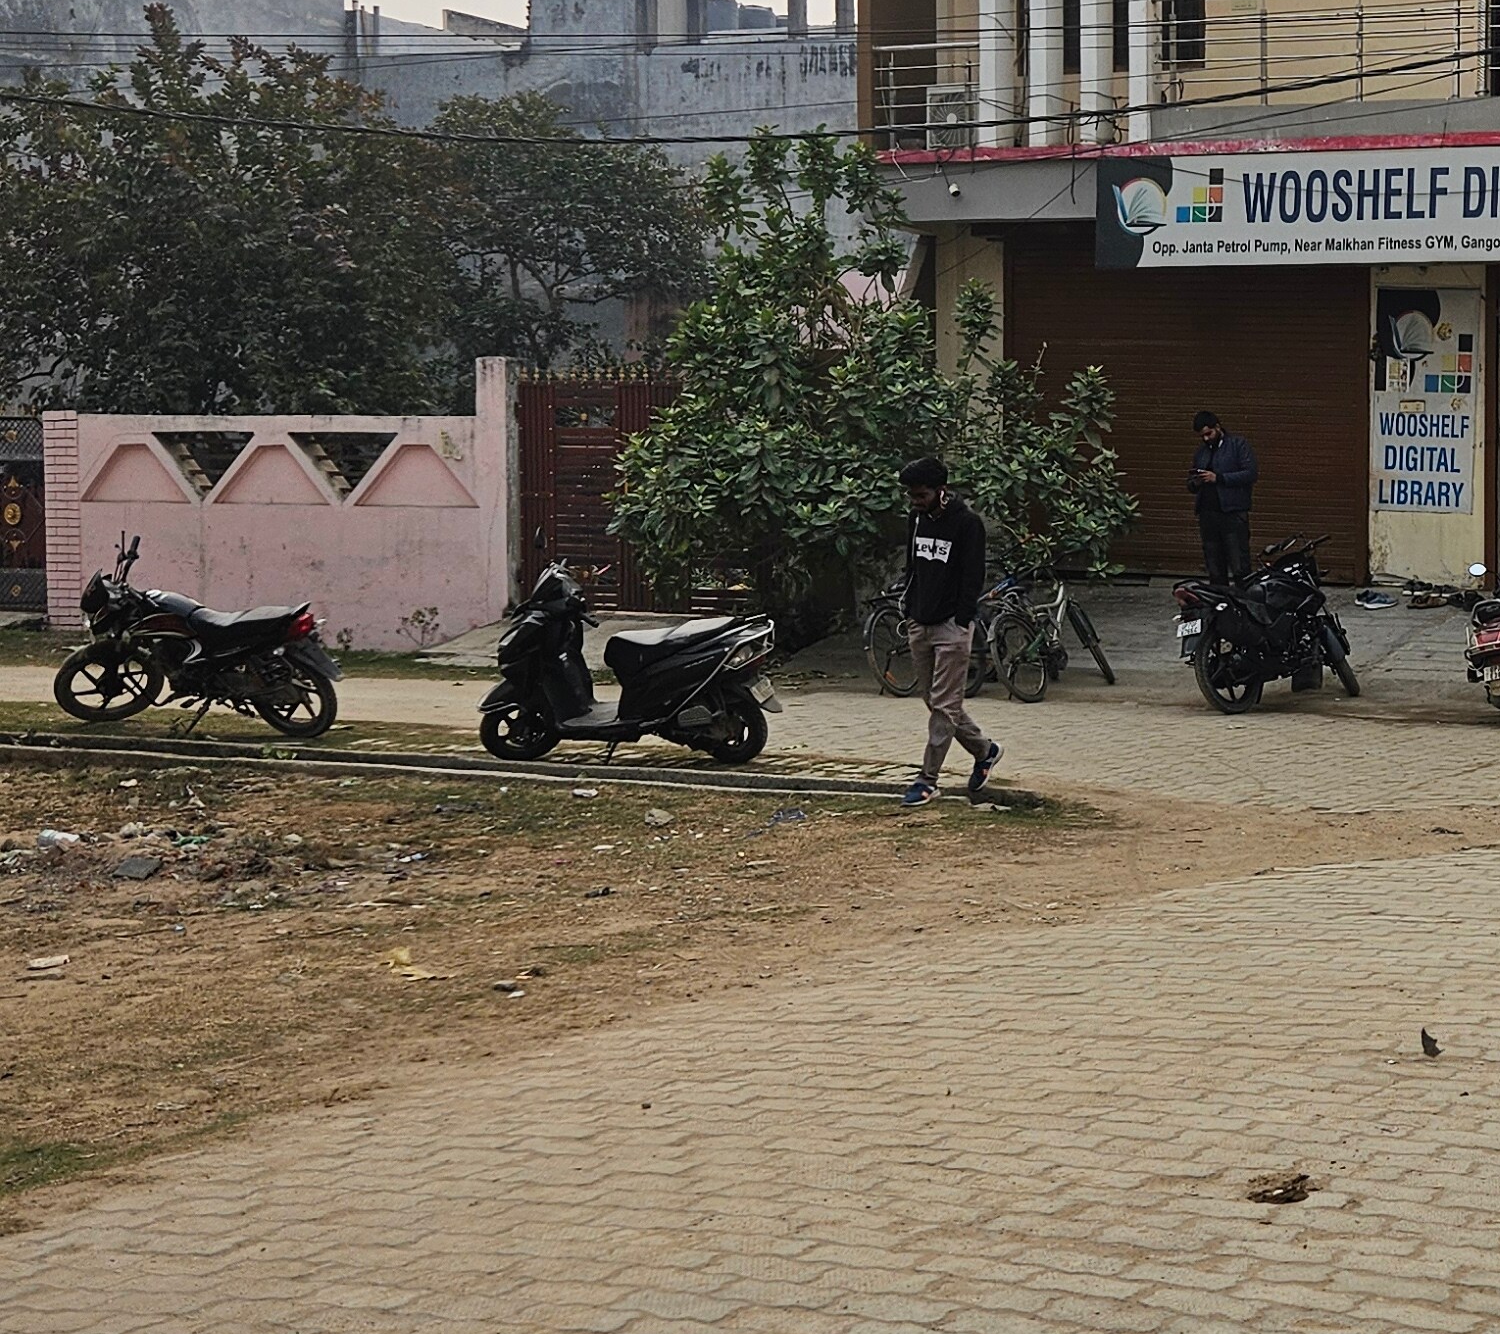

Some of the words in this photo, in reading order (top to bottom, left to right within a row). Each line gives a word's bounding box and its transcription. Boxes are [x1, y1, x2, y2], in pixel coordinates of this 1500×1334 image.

[1243, 168, 1450, 223] WOOSHELF
[1152, 241, 1179, 256] Opp.
[1182, 240, 1213, 253] Janta
[1217, 240, 1250, 253] Petrol
[1255, 239, 1290, 255] Pump,
[1294, 238, 1322, 251] Near
[1325, 238, 1374, 251] Malkhan
[1378, 236, 1422, 250] Fitness
[1425, 235, 1457, 251] GYM,
[1379, 412, 1470, 438] WOOSHELF
[1384, 445, 1461, 473] DIGITAL
[1378, 479, 1464, 507] LIBRARY
